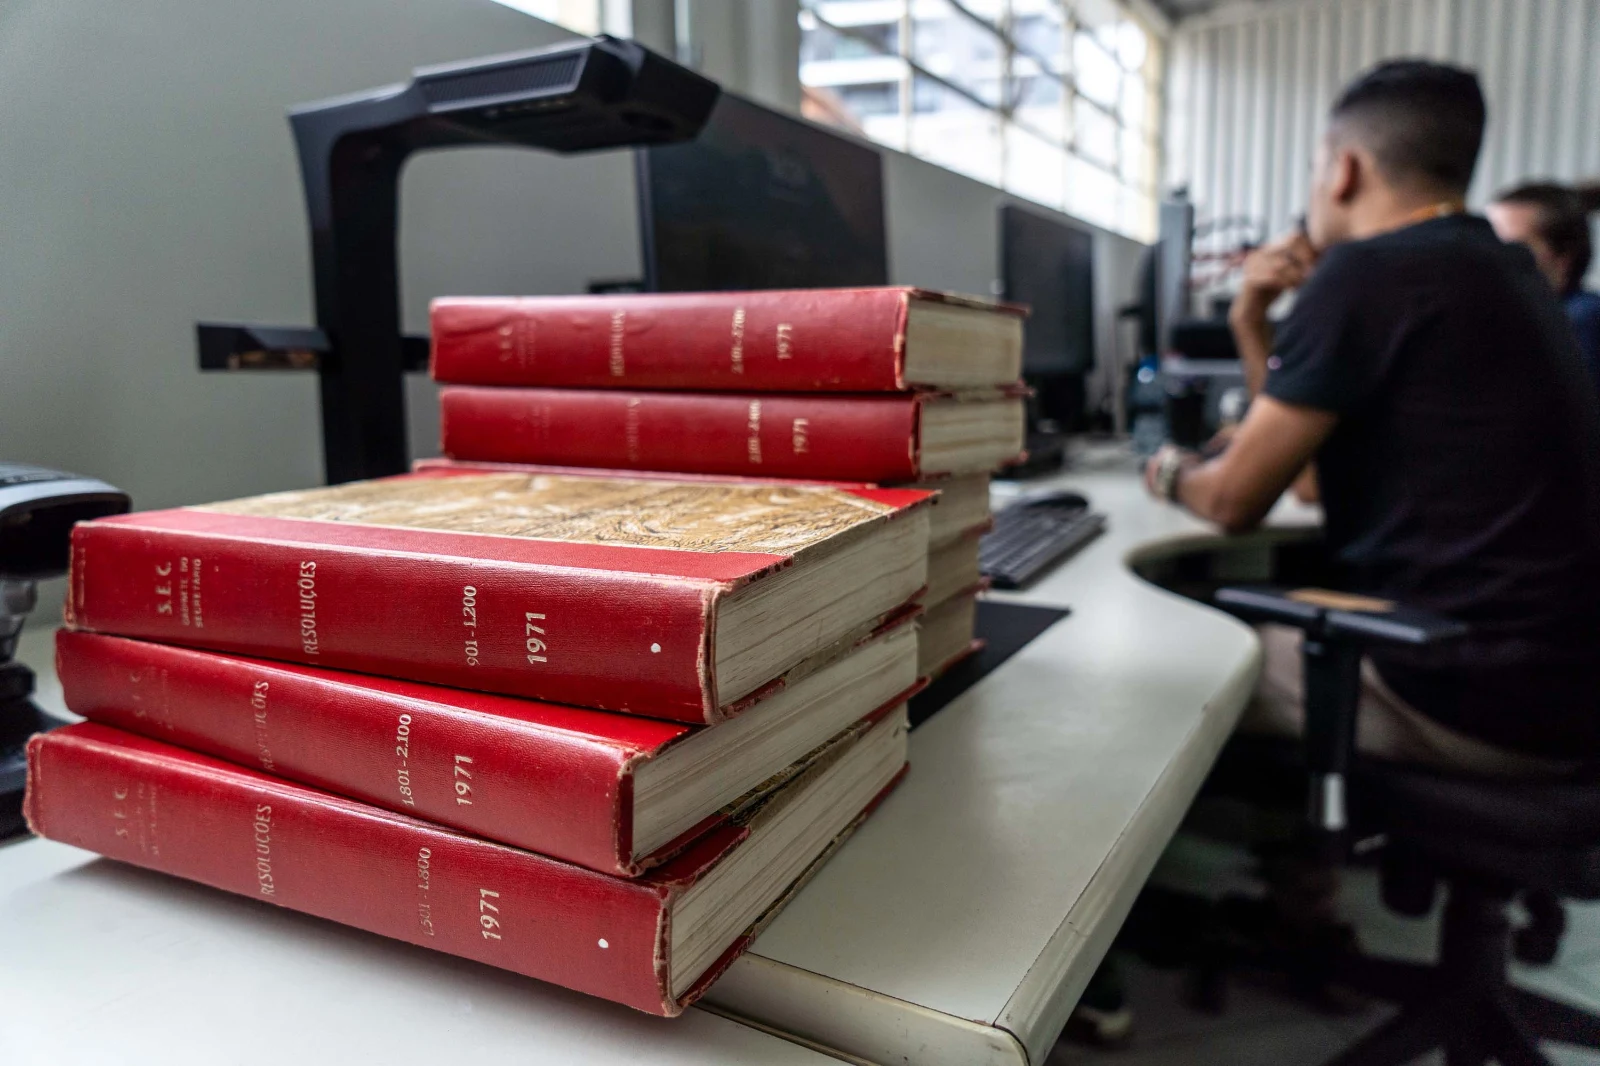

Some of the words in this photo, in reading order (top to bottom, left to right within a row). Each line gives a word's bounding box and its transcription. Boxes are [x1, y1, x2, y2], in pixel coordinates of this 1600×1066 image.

[776, 323, 792, 360] 1971
[298, 561, 319, 655] RESOLUÇÕES
[525, 612, 547, 665] 1971
[454, 754, 473, 806] 1971
[253, 803, 275, 895] RESOLUÇÕES
[479, 888, 502, 941] 1971
